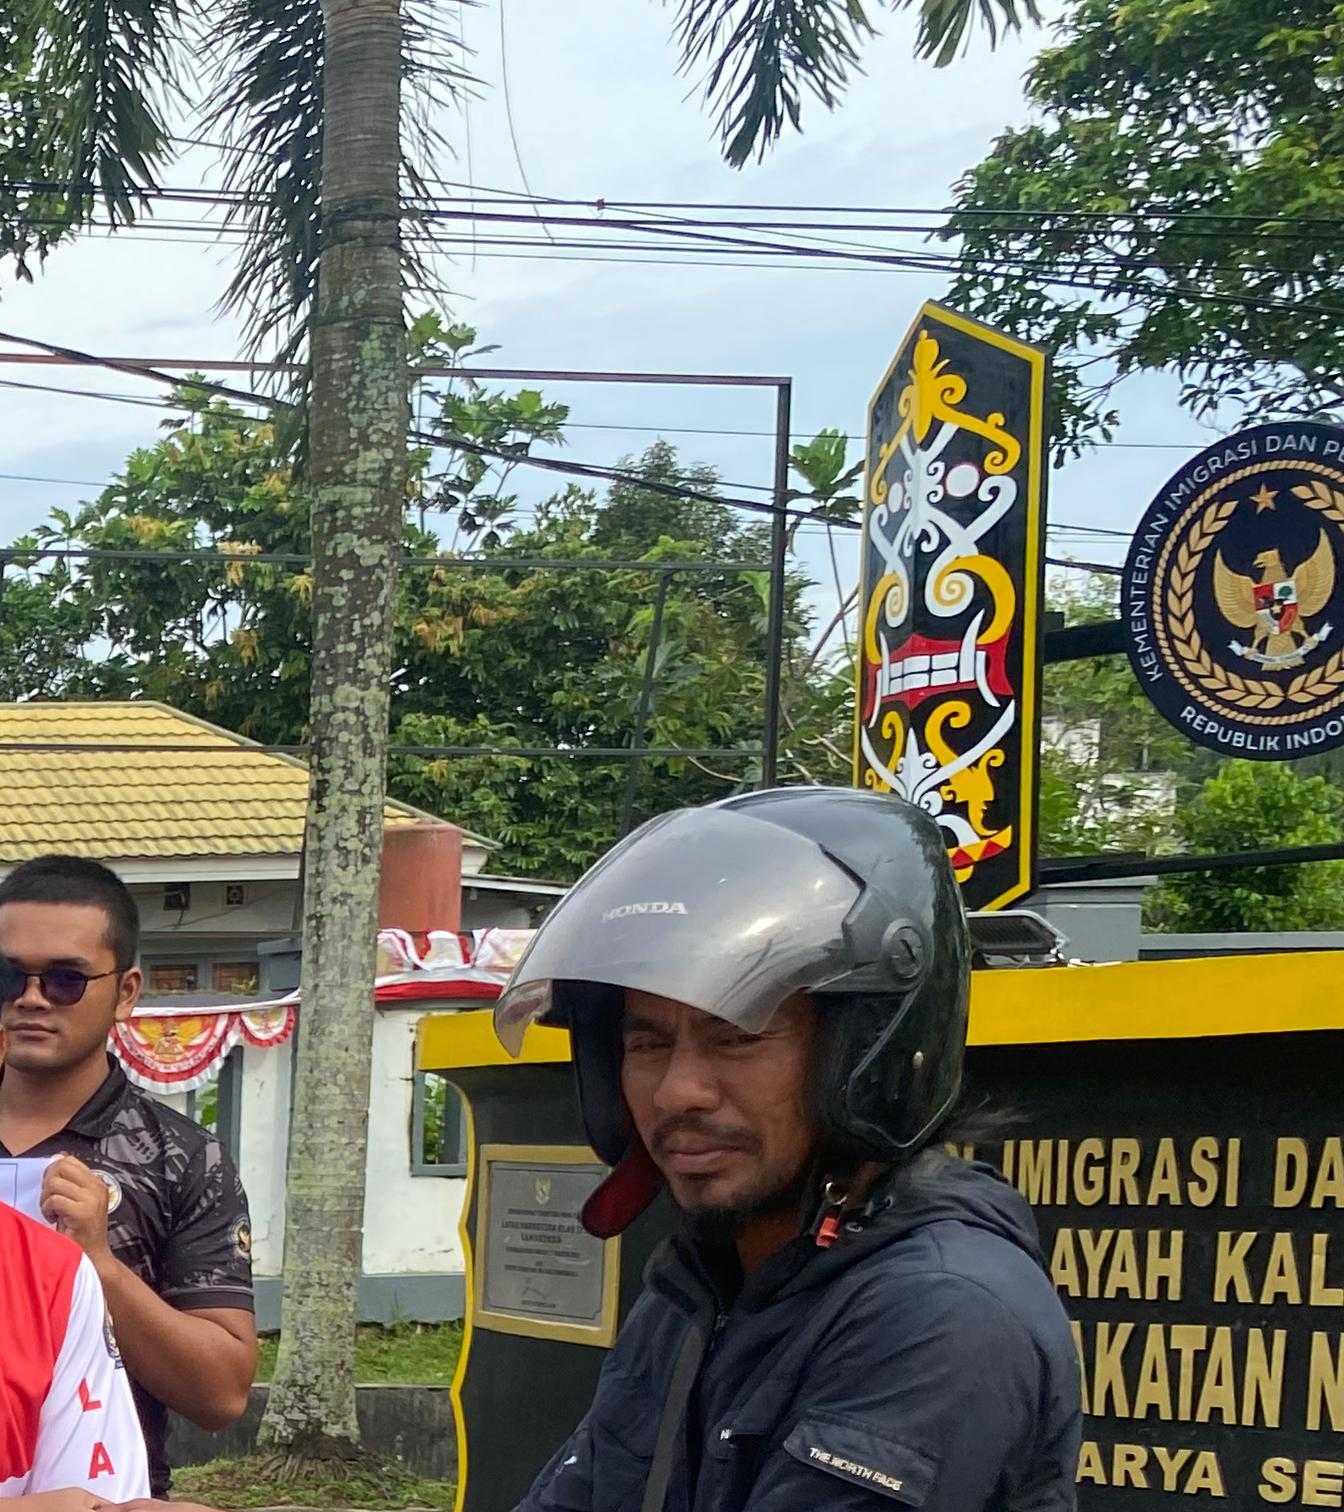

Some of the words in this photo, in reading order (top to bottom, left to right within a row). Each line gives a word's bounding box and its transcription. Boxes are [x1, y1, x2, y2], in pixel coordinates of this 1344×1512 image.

[1130, 514, 1170, 682] KEMENTERIAN
[1164, 440, 1258, 511] IMIGRASI
[1265, 434, 1317, 453] DAN
[1180, 706, 1280, 751] REPUBLIK
[601, 902, 689, 923] HONDA
[1051, 1228, 1184, 1301] AYAH
[1214, 1231, 1344, 1307] KAL
[1076, 1440, 1225, 1498] ARYA
[1258, 1457, 1344, 1508] SE
